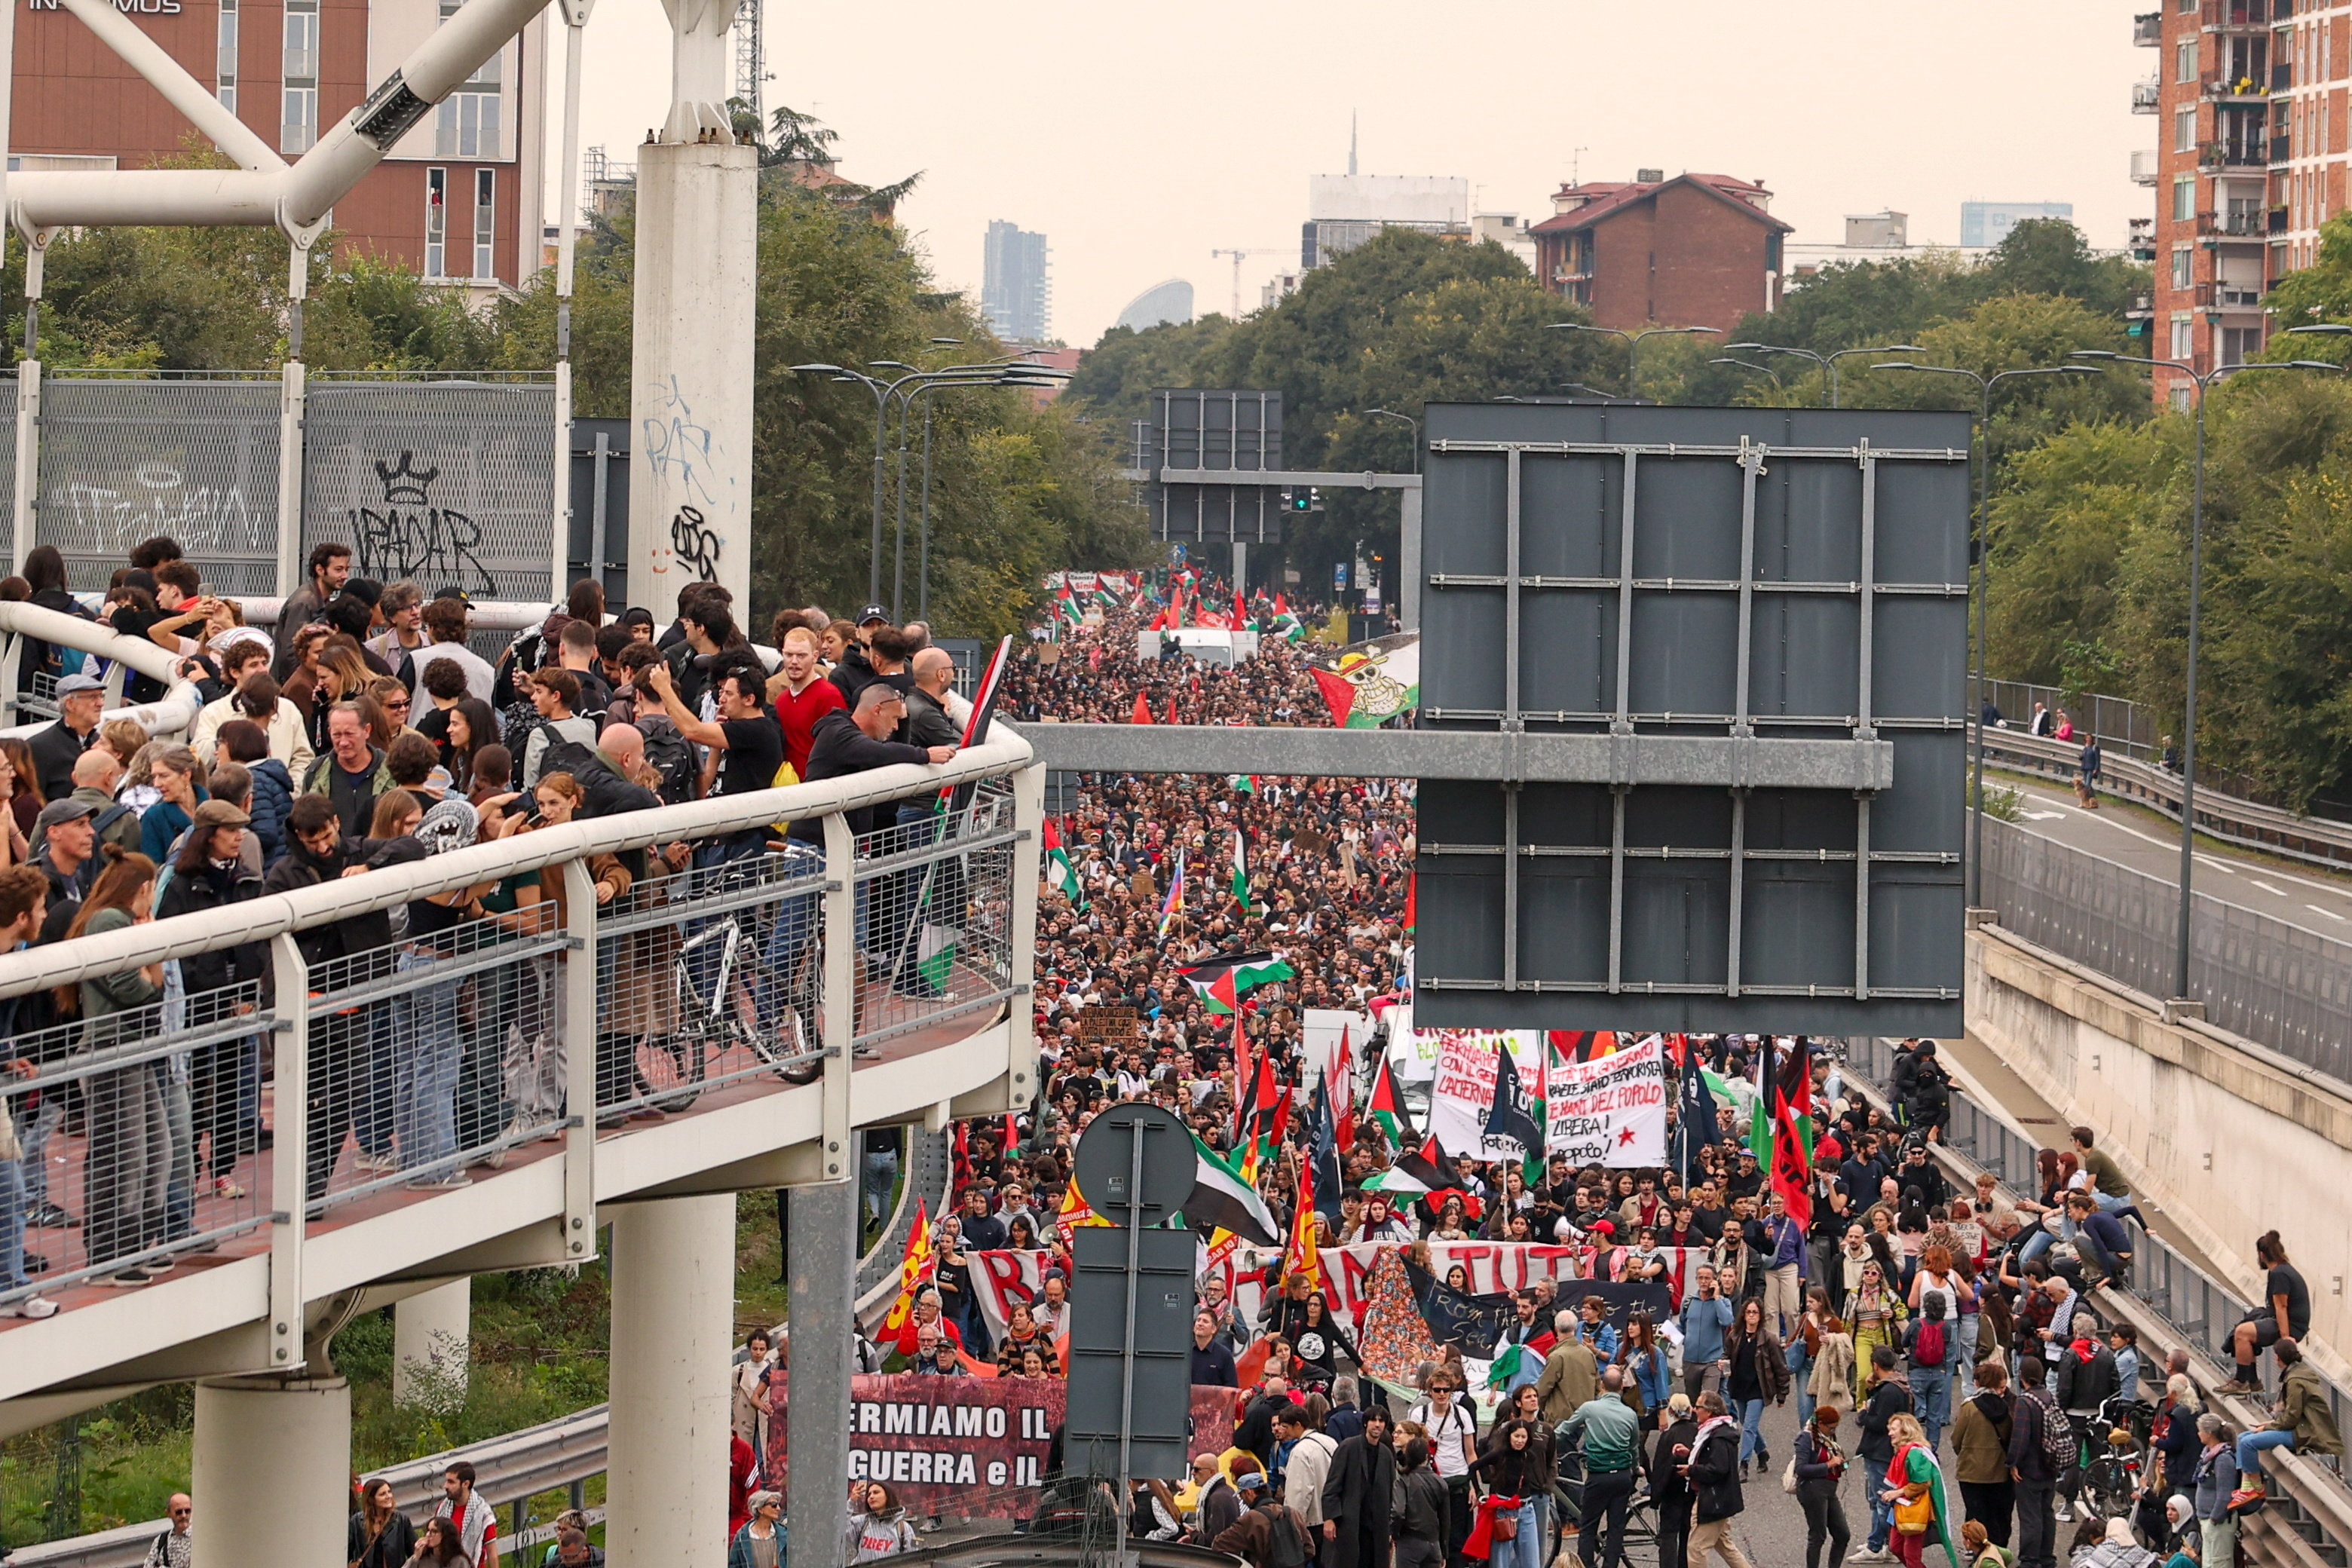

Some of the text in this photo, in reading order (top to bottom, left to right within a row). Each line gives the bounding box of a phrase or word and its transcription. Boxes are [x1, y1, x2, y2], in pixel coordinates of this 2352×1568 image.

[29, 0, 181, 14] IN-MUS
[1441, 1055, 1464, 1074] CON
[1465, 1062, 1475, 1077] IL
[1591, 1090, 1615, 1113] DEL
[1619, 1081, 1661, 1108] POPOLO
[1480, 1134, 1527, 1156] potere
[1021, 1408, 1051, 1440] IL
[847, 1449, 1043, 1487] GUERRA e IL
